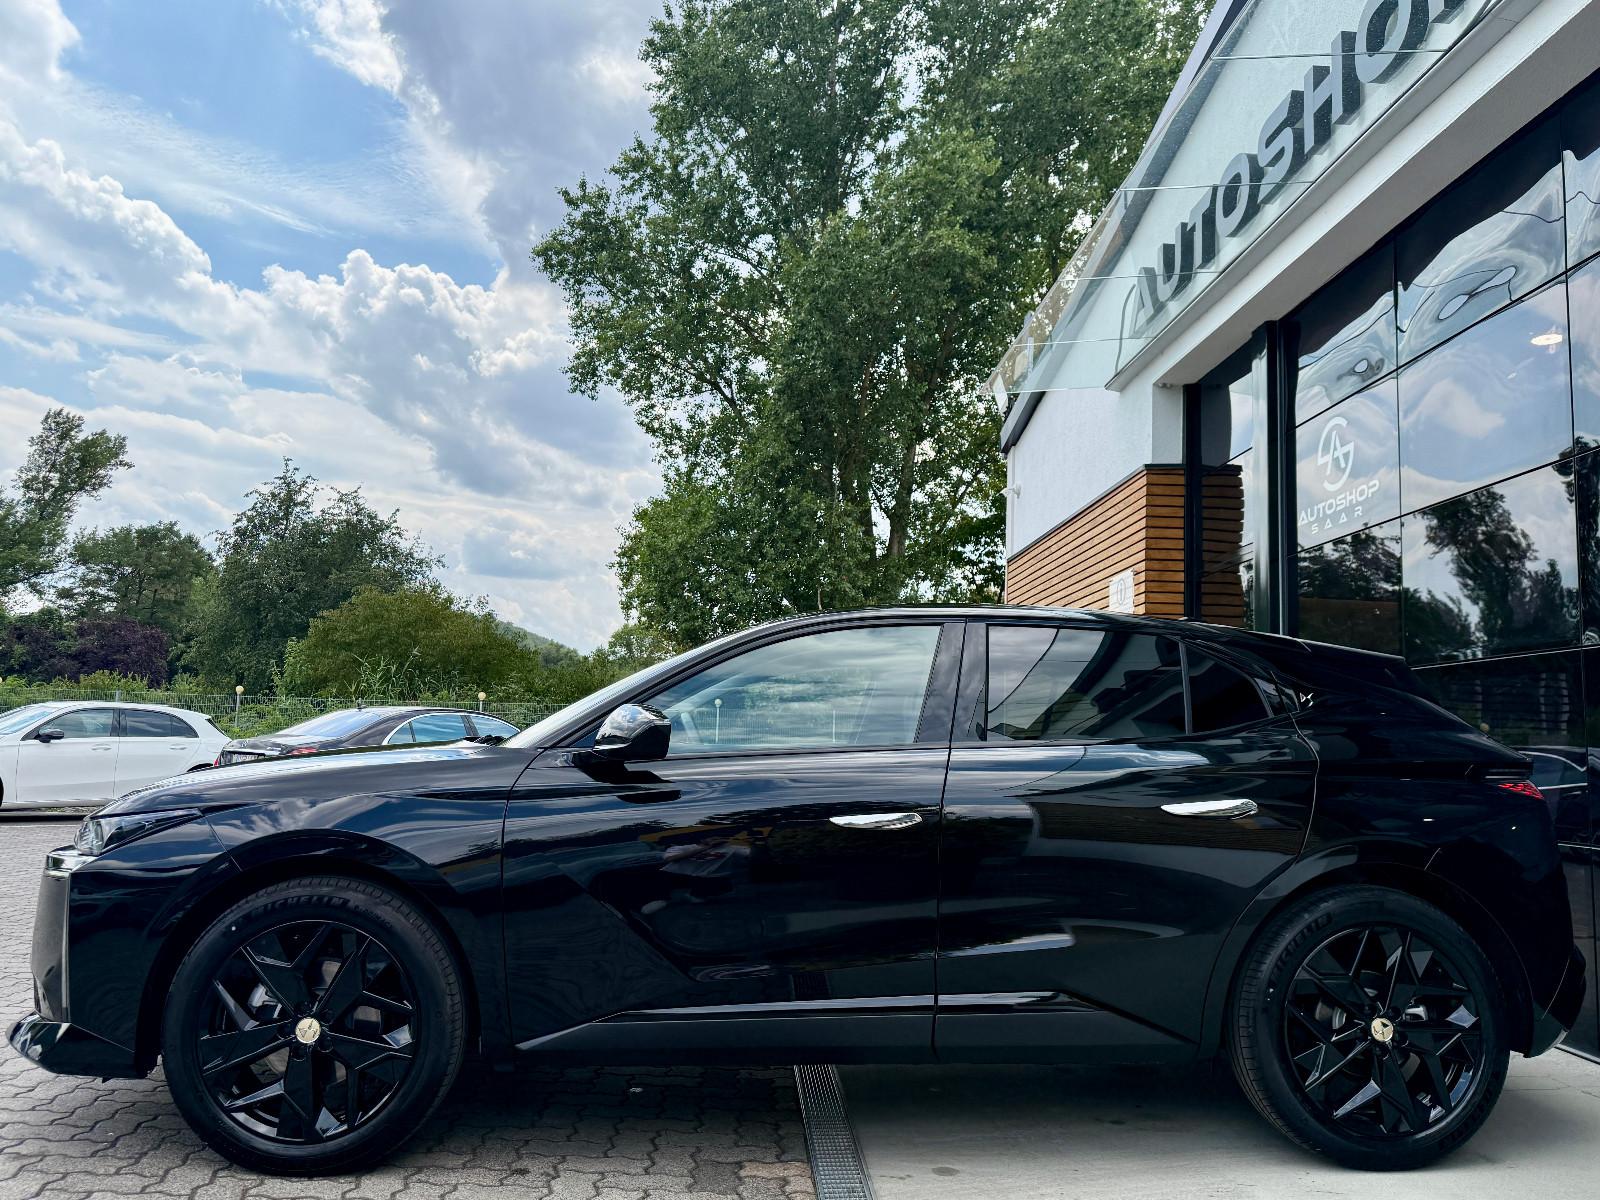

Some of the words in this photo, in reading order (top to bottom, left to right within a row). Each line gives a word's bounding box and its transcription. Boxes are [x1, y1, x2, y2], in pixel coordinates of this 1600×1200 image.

[1128, 0, 1465, 338] AUTOSHO
[1298, 480, 1379, 526] AUTOSHOP
[1311, 507, 1362, 534] SAAR
